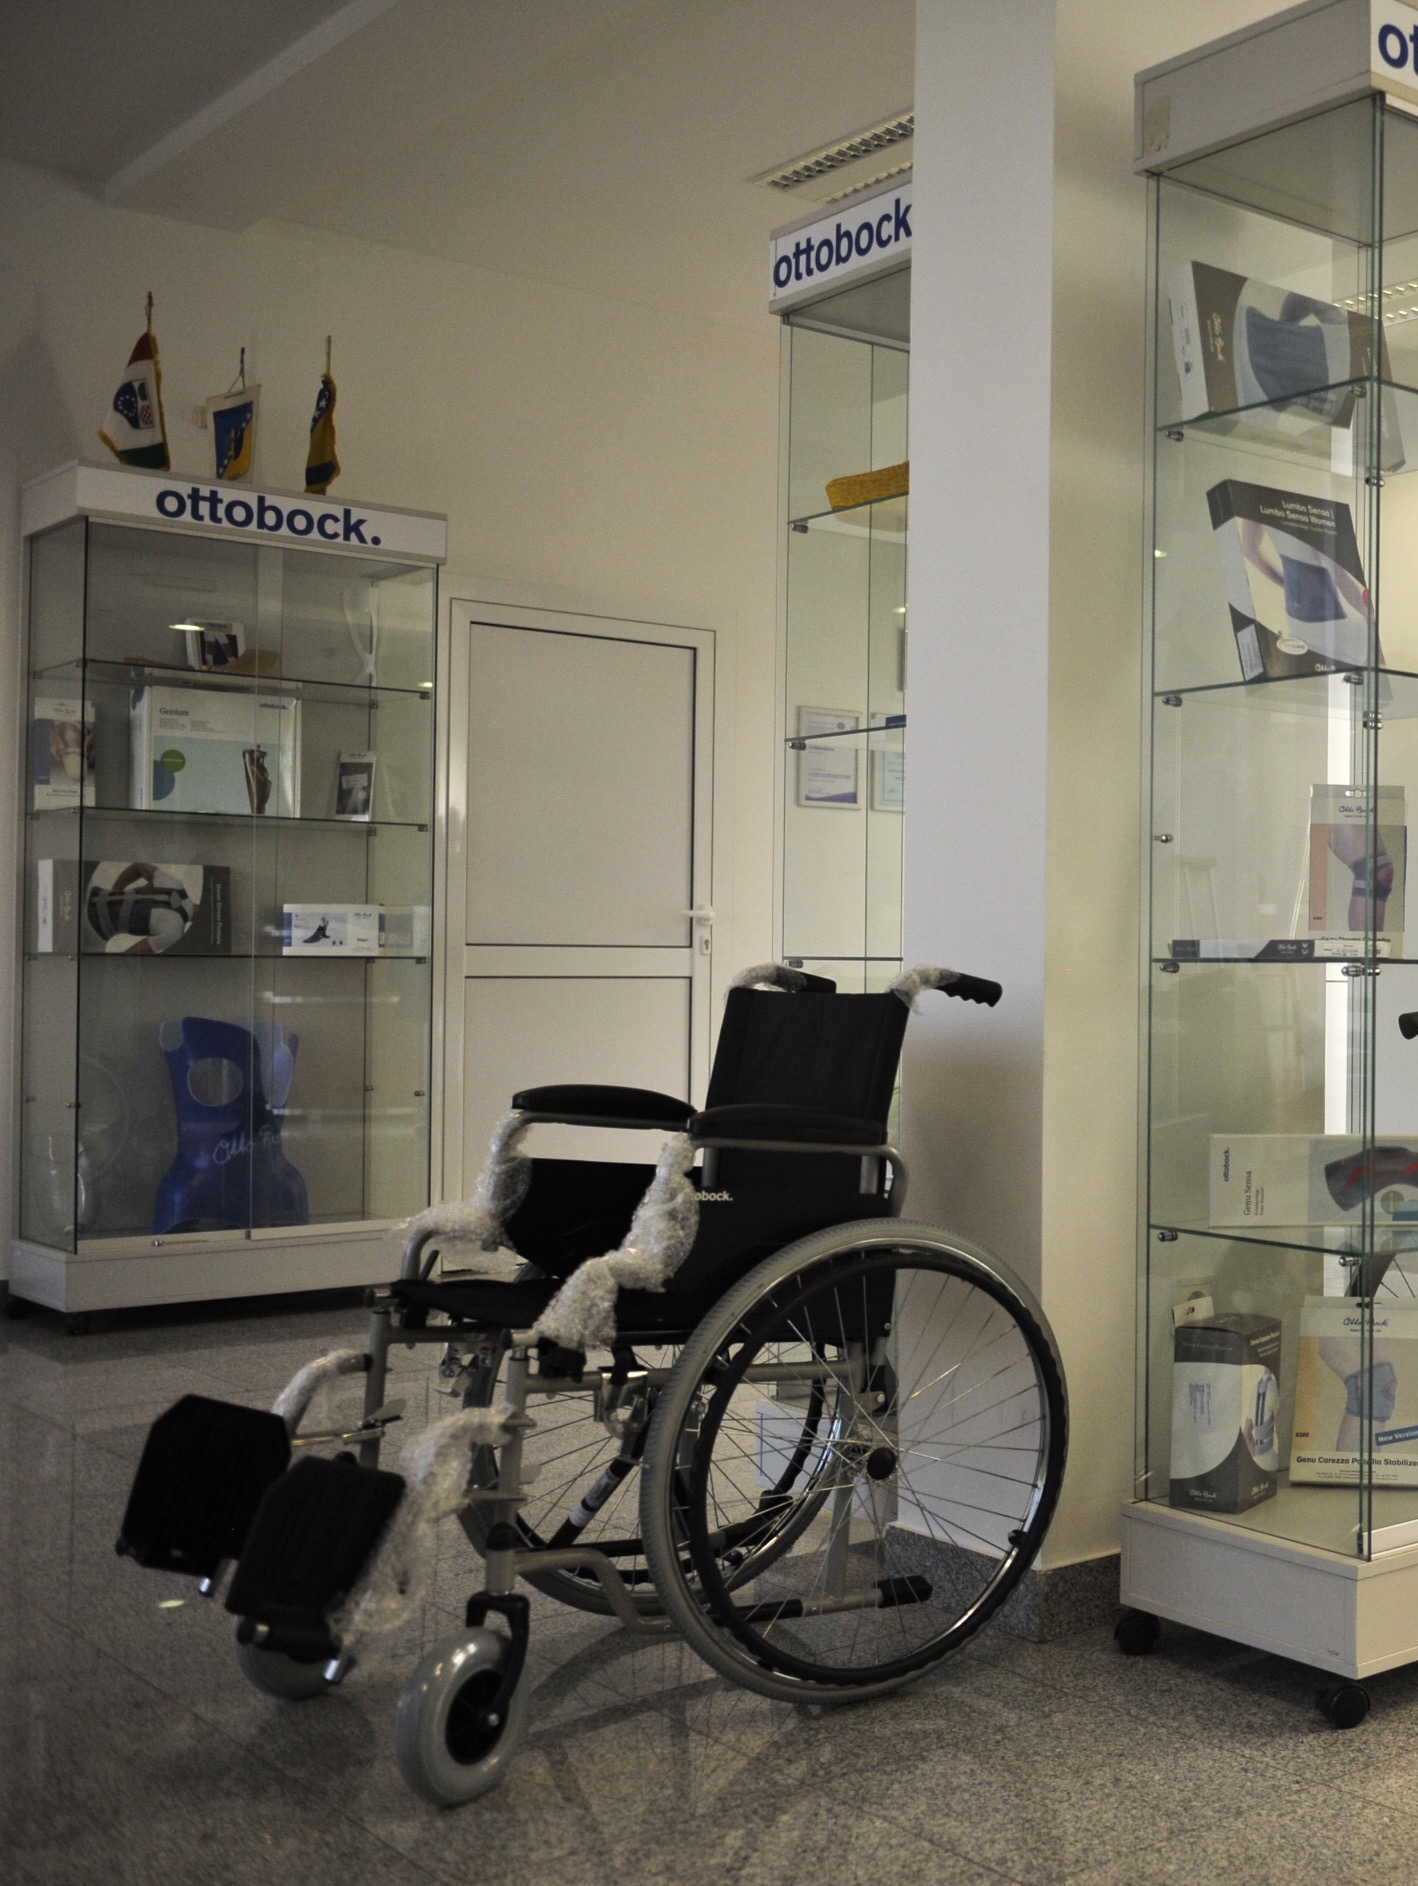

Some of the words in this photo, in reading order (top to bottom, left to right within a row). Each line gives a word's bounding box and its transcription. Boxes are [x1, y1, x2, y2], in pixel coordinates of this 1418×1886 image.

[773, 197, 912, 288] ottobock
[156, 486, 382, 546] ottobock.
[1259, 505, 1286, 518] Lumbo
[1285, 510, 1309, 523] Sensa
[1309, 515, 1336, 528] Women
[1282, 500, 1307, 513] Lumbo
[1307, 505, 1330, 518] Sensa
[1243, 1170, 1252, 1194] Sensa
[1243, 1194, 1252, 1216] Genu
[1377, 1434, 1393, 1443] New
[1296, 1455, 1316, 1464] Genu
[1318, 1456, 1350, 1465] Carezza
